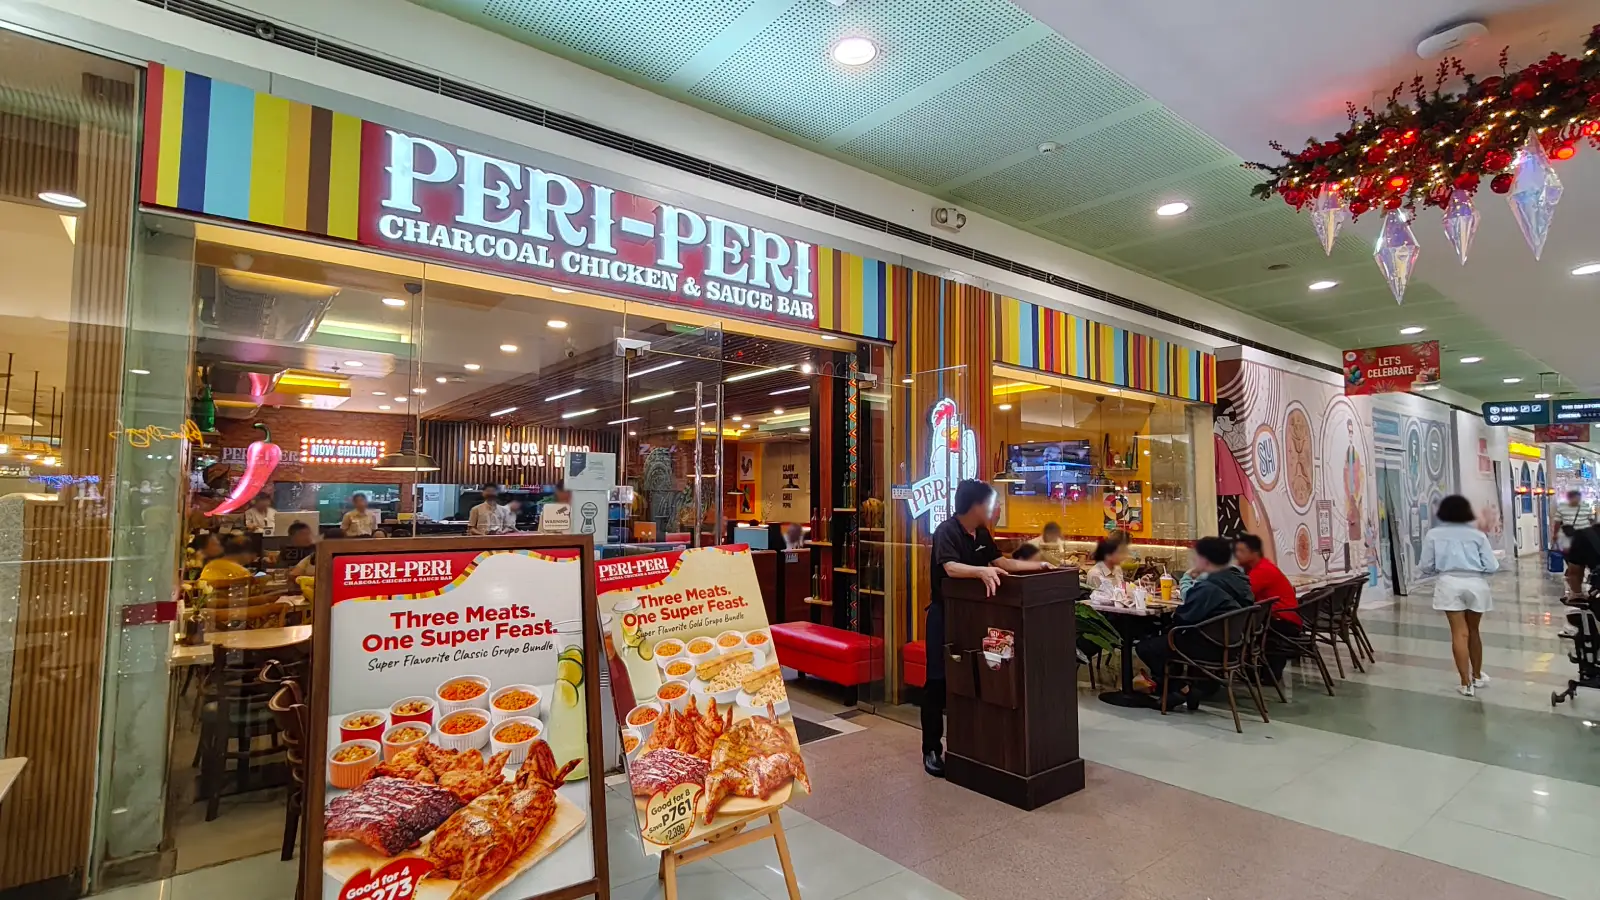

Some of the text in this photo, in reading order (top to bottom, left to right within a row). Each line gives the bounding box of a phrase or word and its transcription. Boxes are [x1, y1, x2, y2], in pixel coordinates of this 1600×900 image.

[380, 129, 814, 299] PERI-PERI
[378, 213, 815, 320] CHARCOAL CHICKEN & SAUCE BAR
[1367, 364, 1414, 379] CELEBRATE
[1378, 355, 1401, 367] LET'S
[310, 444, 377, 458] NOW GRILLING
[469, 439, 495, 453] LET
[501, 441, 539, 455] YOUR
[469, 453, 546, 467] ADVENTURE
[344, 559, 453, 581] PERI-PERI
[598, 556, 669, 578] PERI-PERI
[637, 584, 732, 609] Three Meats.
[390, 603, 536, 630] Three Meats.
[623, 595, 749, 628] One Super Feast.
[362, 619, 558, 652] One Super Feast.
[635, 612, 745, 641] Super Flavorite Gold Grupo Bundle
[367, 640, 554, 672] Super Flavorite Classic Grupo Bundle
[650, 788, 691, 816] Good for 8
[648, 822, 663, 834] Save
[345, 865, 411, 900] Good for 4
[360, 875, 413, 900] 273
